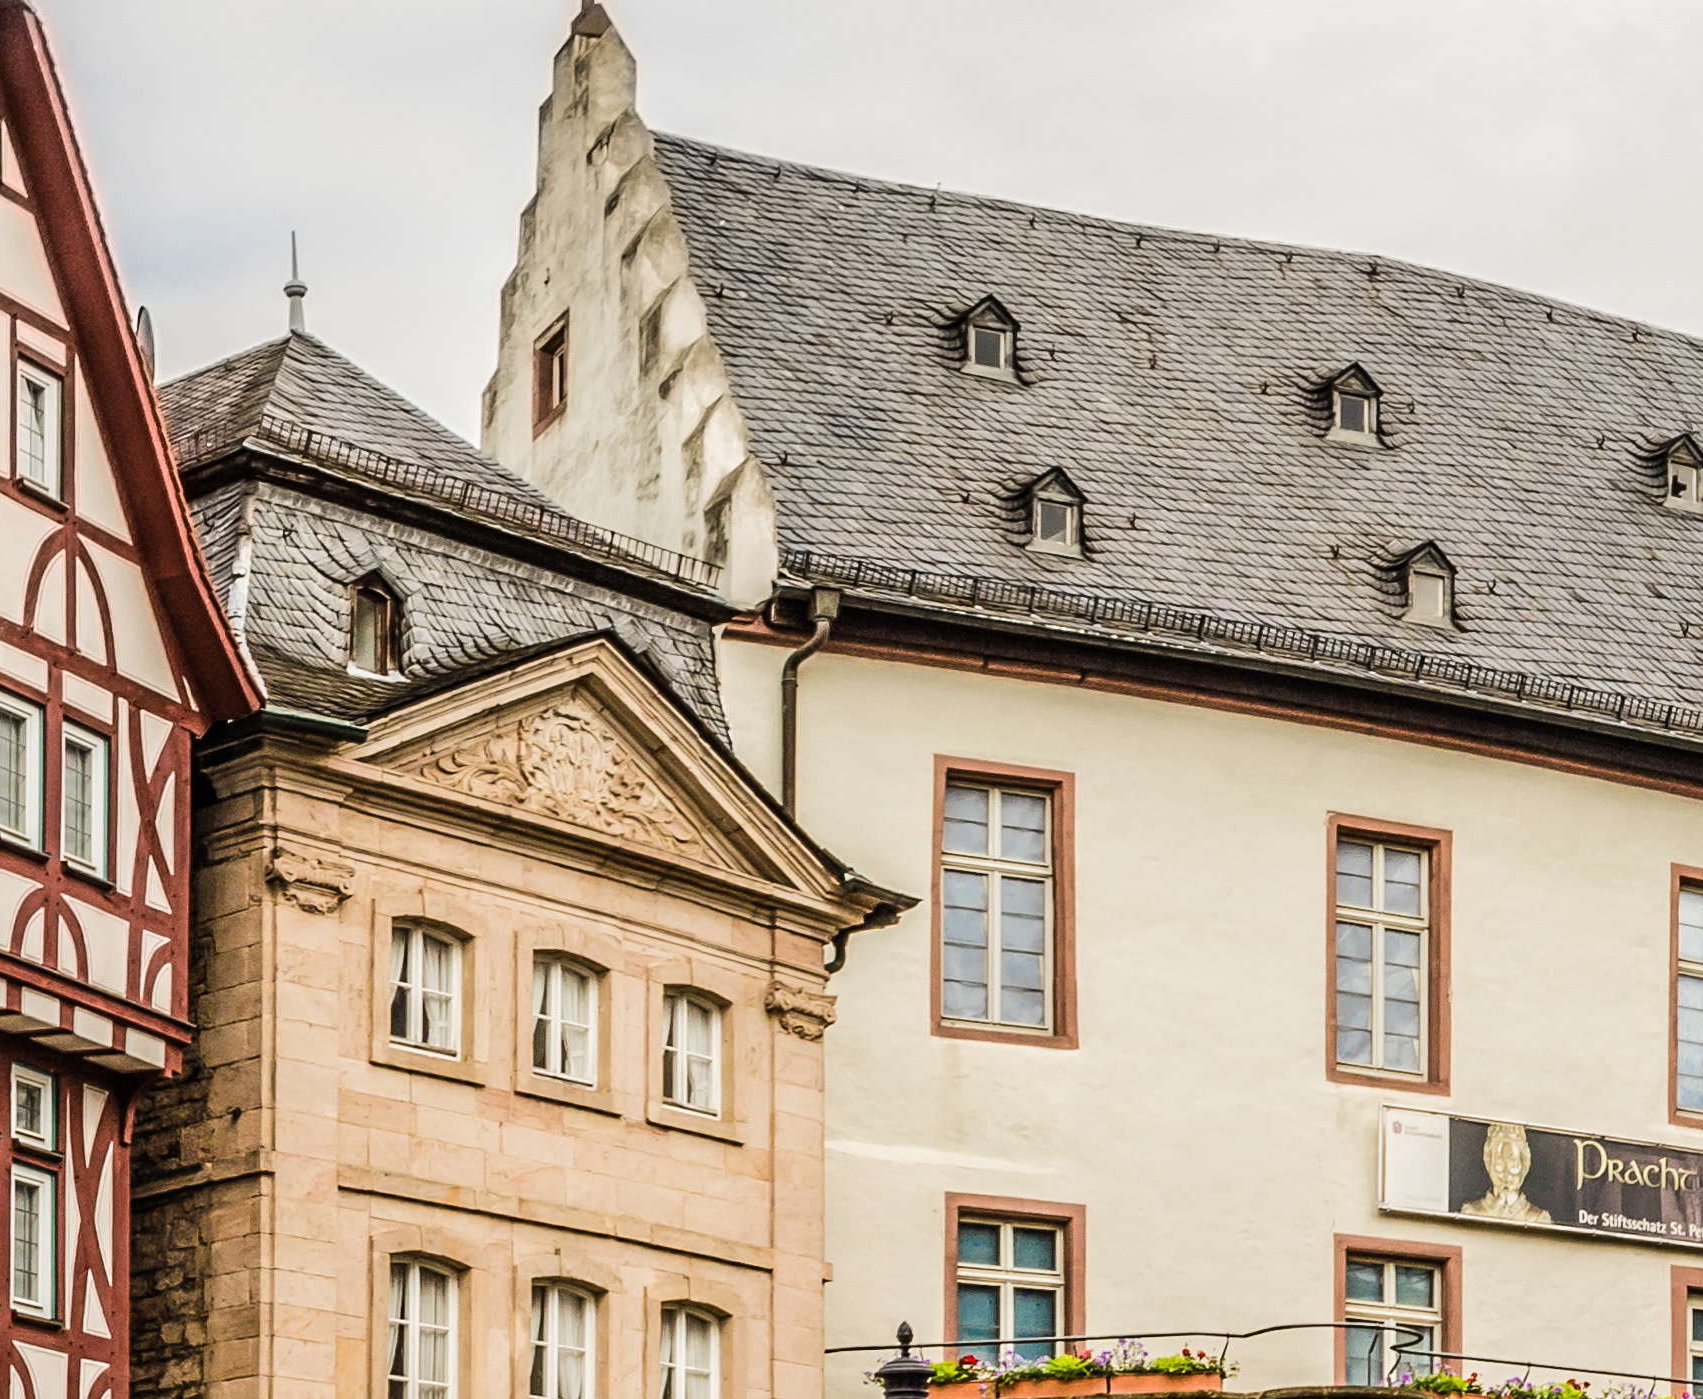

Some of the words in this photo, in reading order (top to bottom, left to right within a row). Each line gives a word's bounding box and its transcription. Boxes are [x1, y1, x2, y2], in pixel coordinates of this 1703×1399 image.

[1573, 1138, 1697, 1191] Pracht
[1578, 1209, 1599, 1226] Der
[1601, 1211, 1667, 1235] Stiftsschatz
[1670, 1221, 1686, 1237] St.
